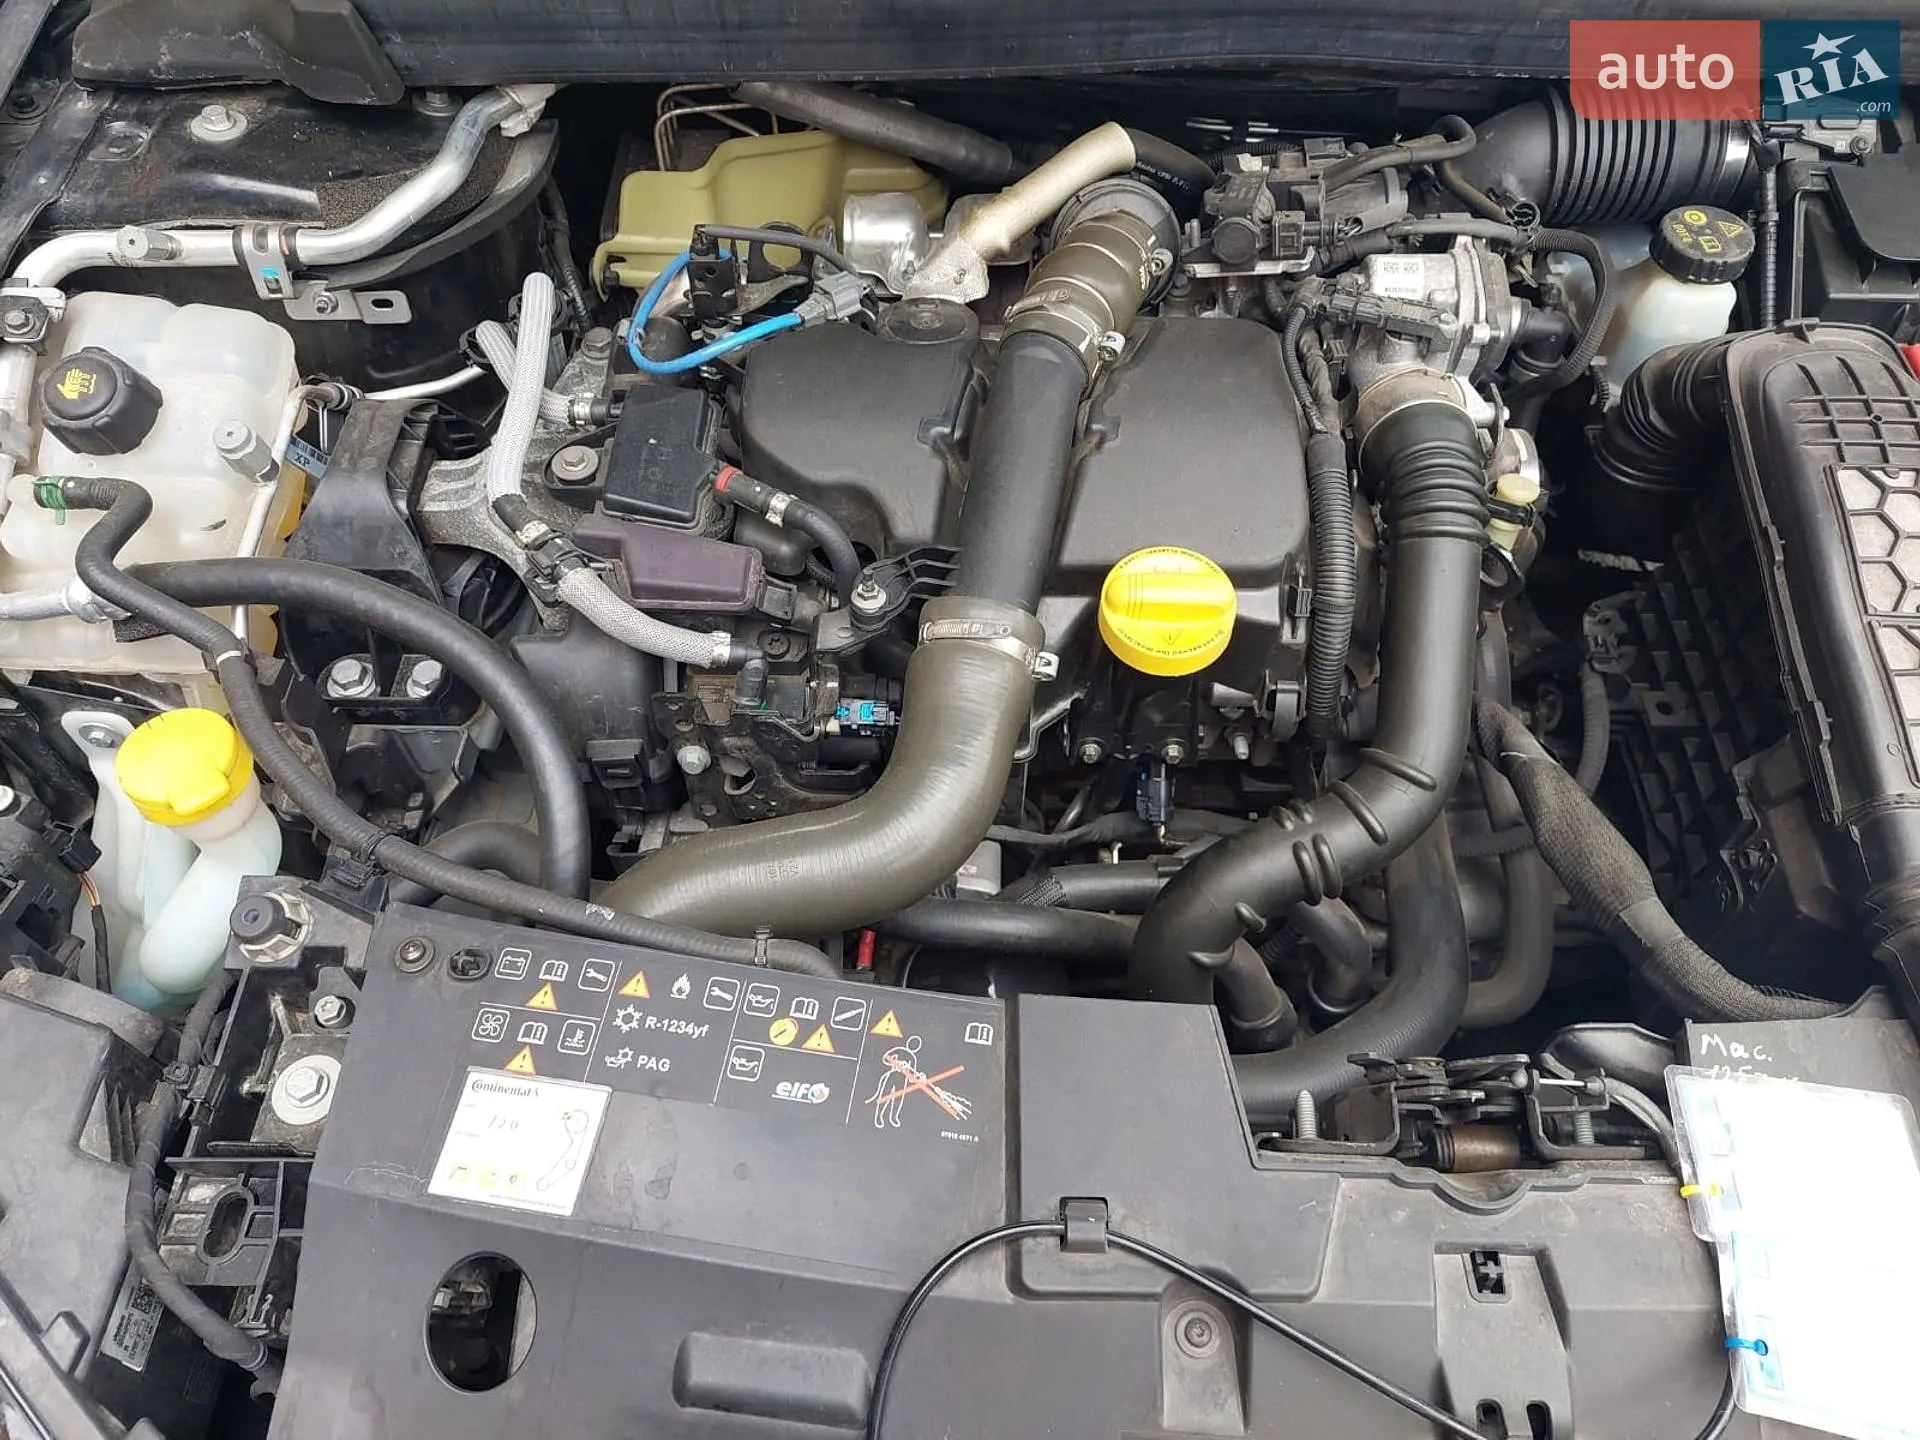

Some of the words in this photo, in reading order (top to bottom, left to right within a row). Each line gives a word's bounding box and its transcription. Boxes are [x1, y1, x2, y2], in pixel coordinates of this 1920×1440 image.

[645, 1016, 709, 1039] R-1234yf
[637, 1055, 671, 1072] PAG
[471, 1079, 531, 1097] Continental
[776, 1081, 811, 1099] elf
